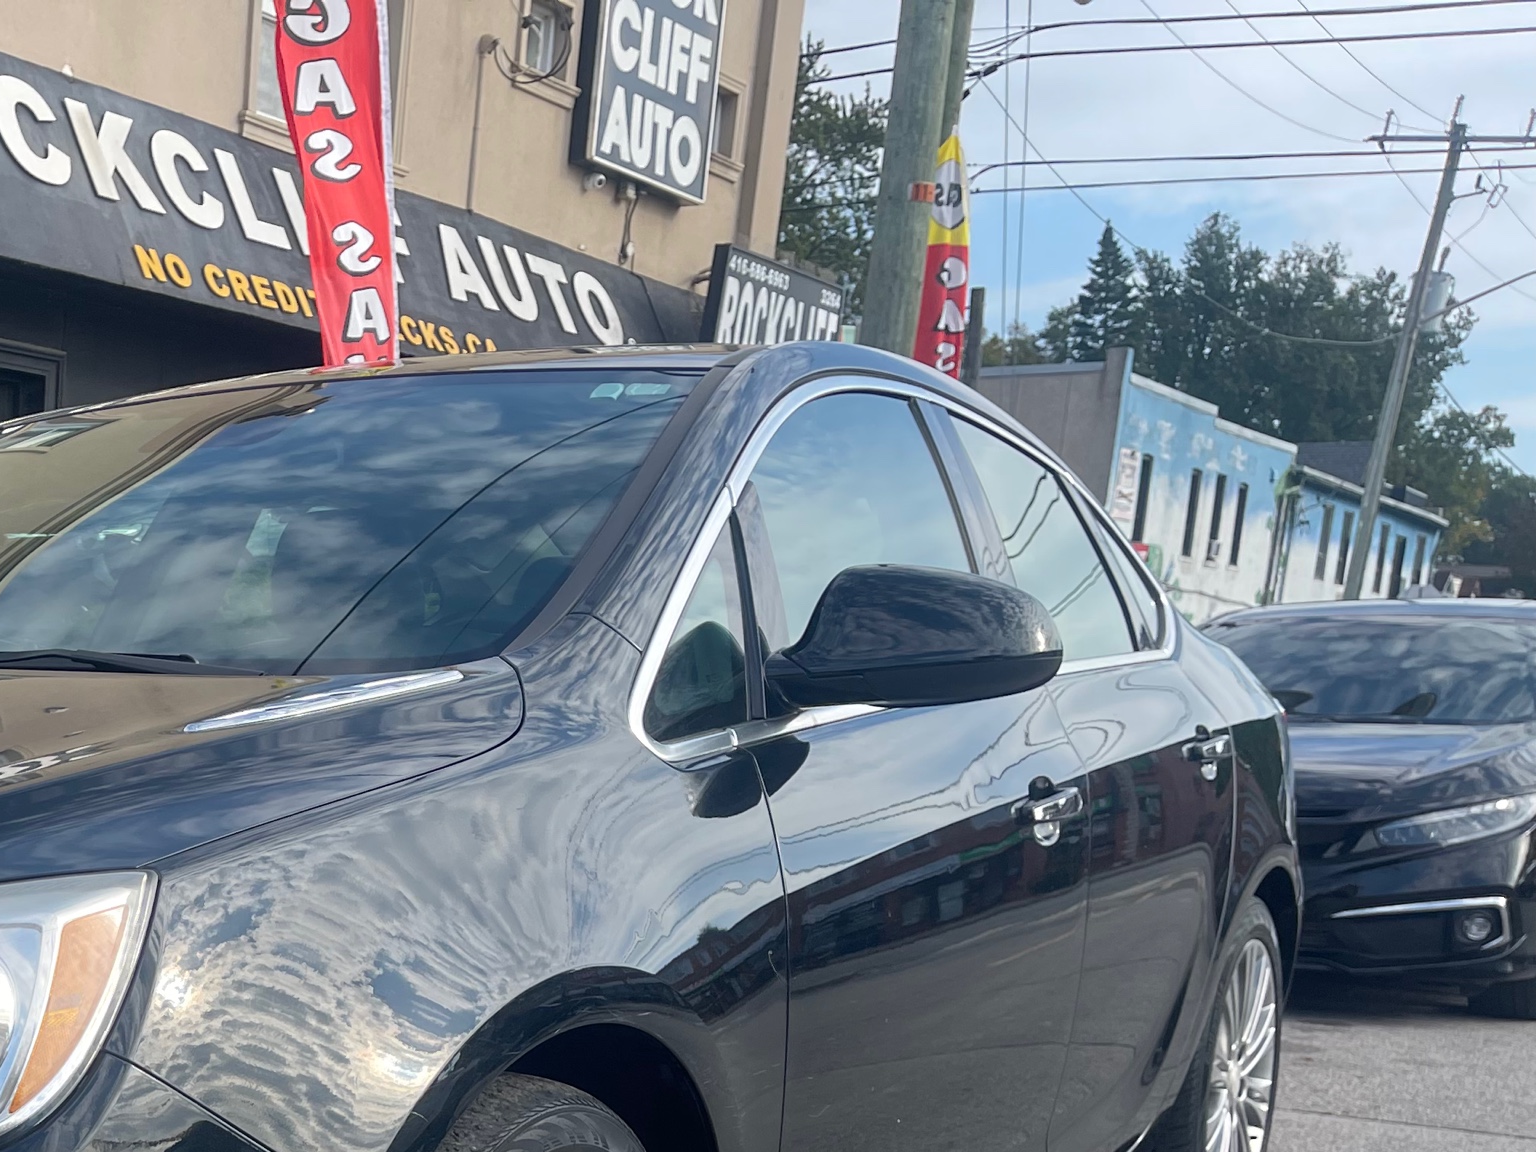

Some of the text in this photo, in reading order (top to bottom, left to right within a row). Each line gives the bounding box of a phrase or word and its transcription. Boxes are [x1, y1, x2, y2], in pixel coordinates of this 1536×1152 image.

[611, 0, 712, 104] CLIFF
[600, 85, 701, 187] AUTO
[134, 244, 192, 288] NO
[439, 223, 624, 346] AUTO
